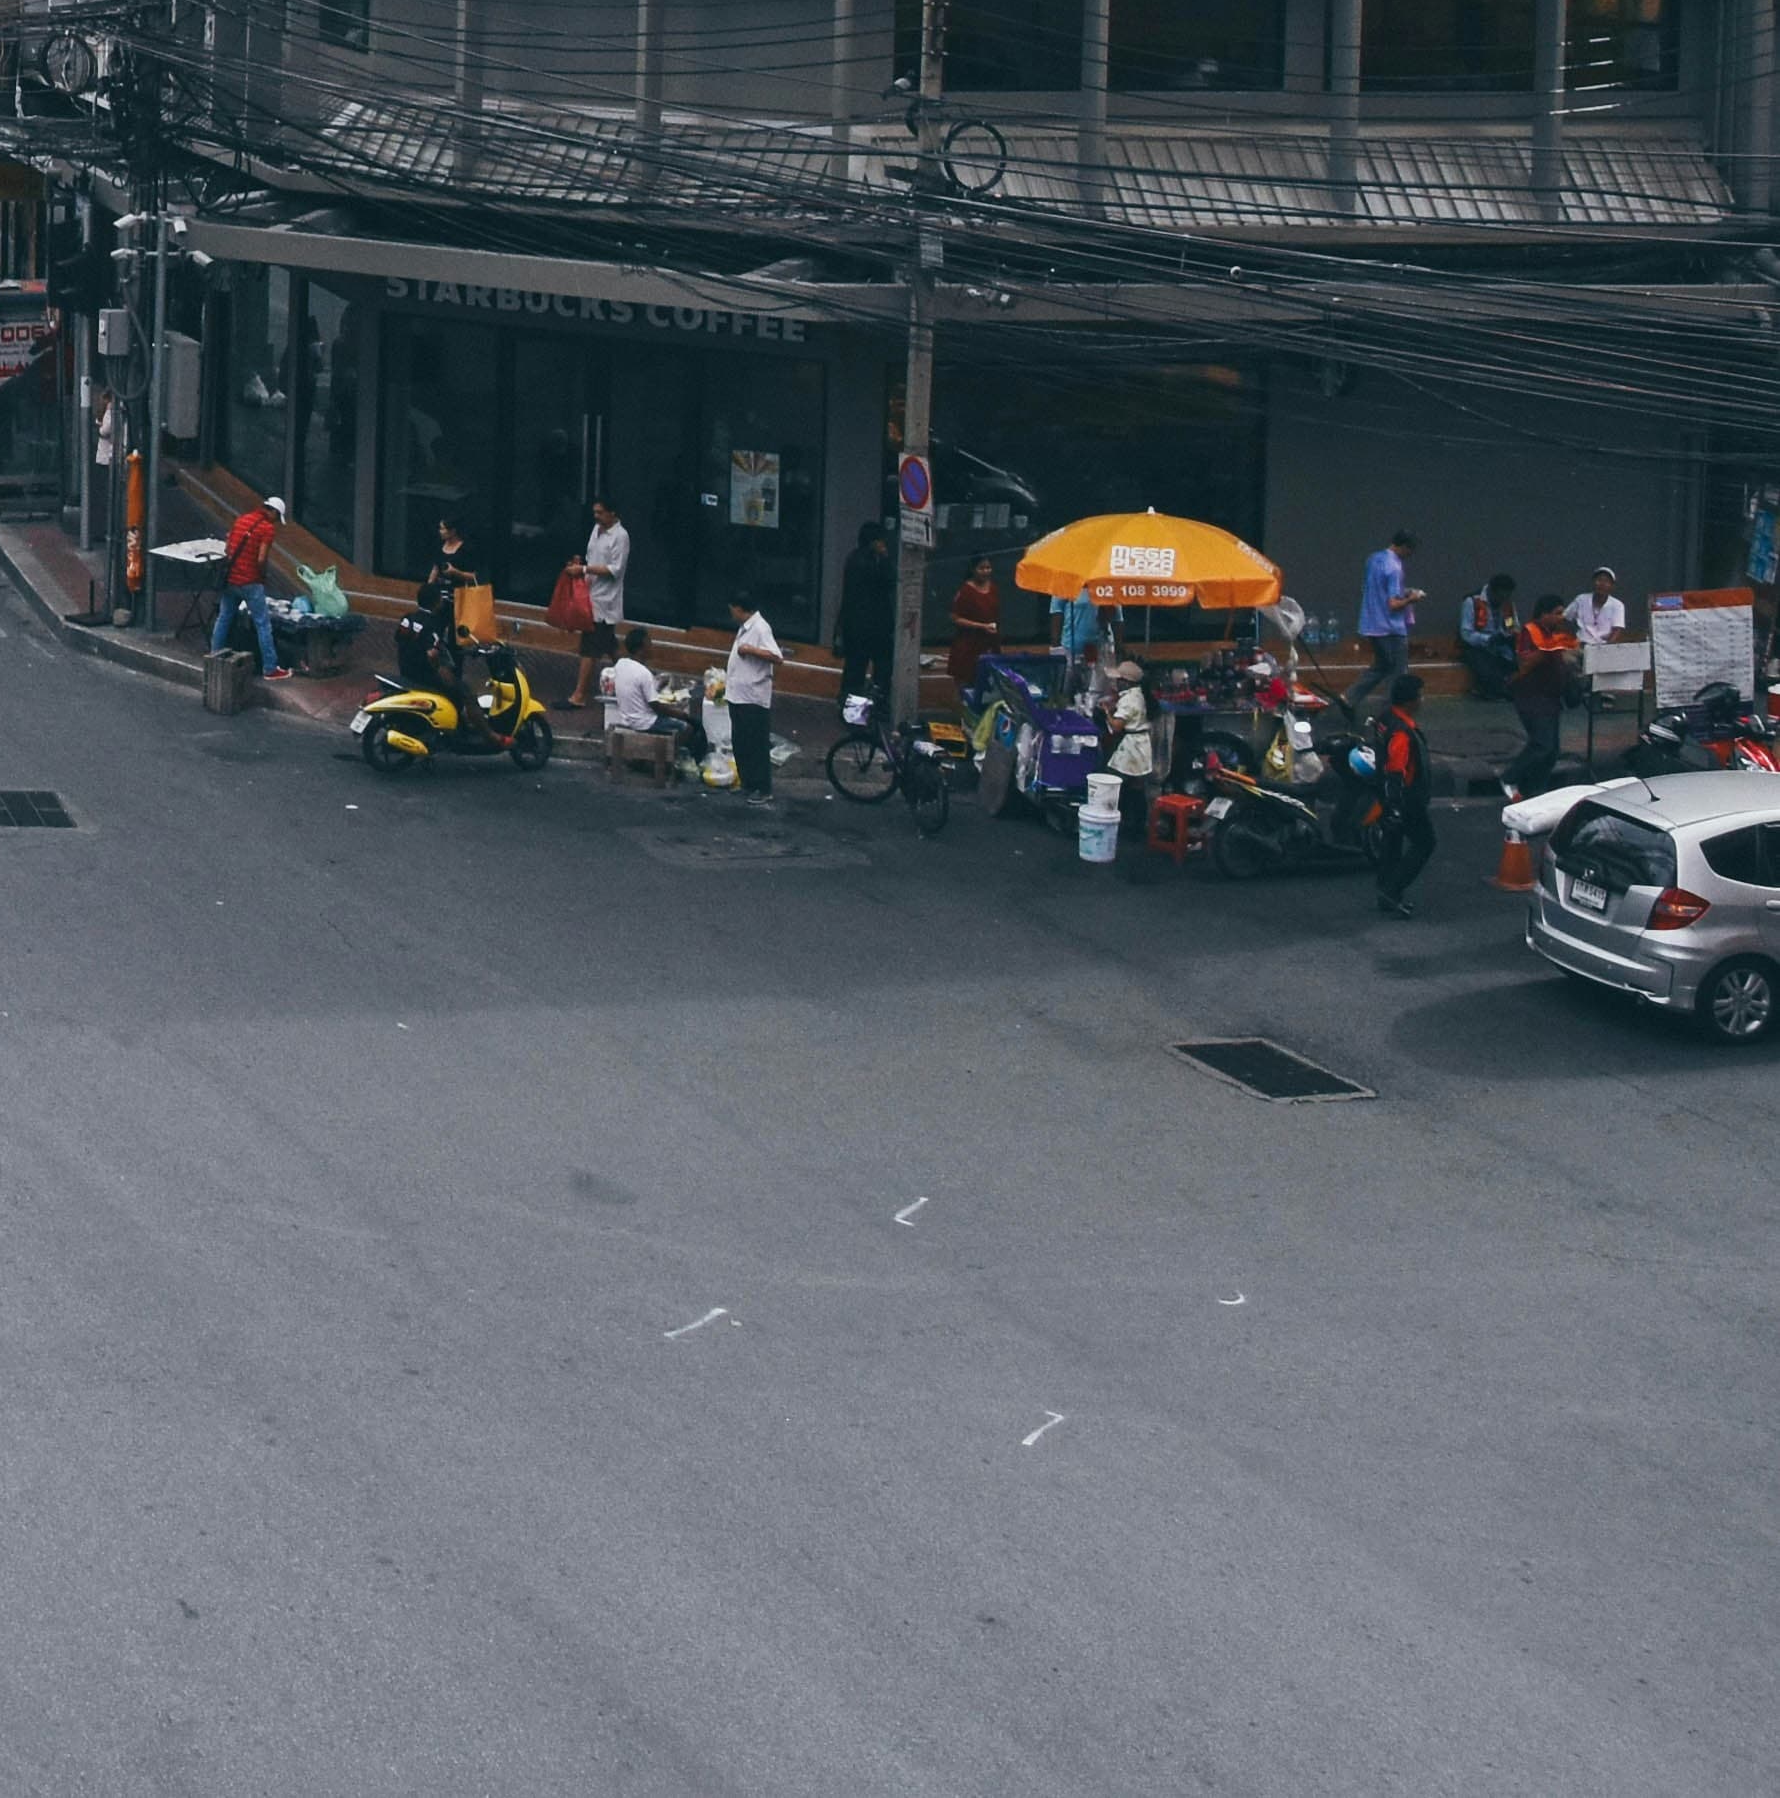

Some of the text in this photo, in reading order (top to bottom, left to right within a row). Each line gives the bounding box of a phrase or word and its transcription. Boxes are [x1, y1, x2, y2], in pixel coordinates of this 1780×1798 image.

[385, 276, 807, 343] STARBUCKS COFFEE
[1112, 545, 1176, 560] MEGA
[1111, 560, 1175, 572] PLAZA
[1096, 584, 1187, 598] 02 108 3999
